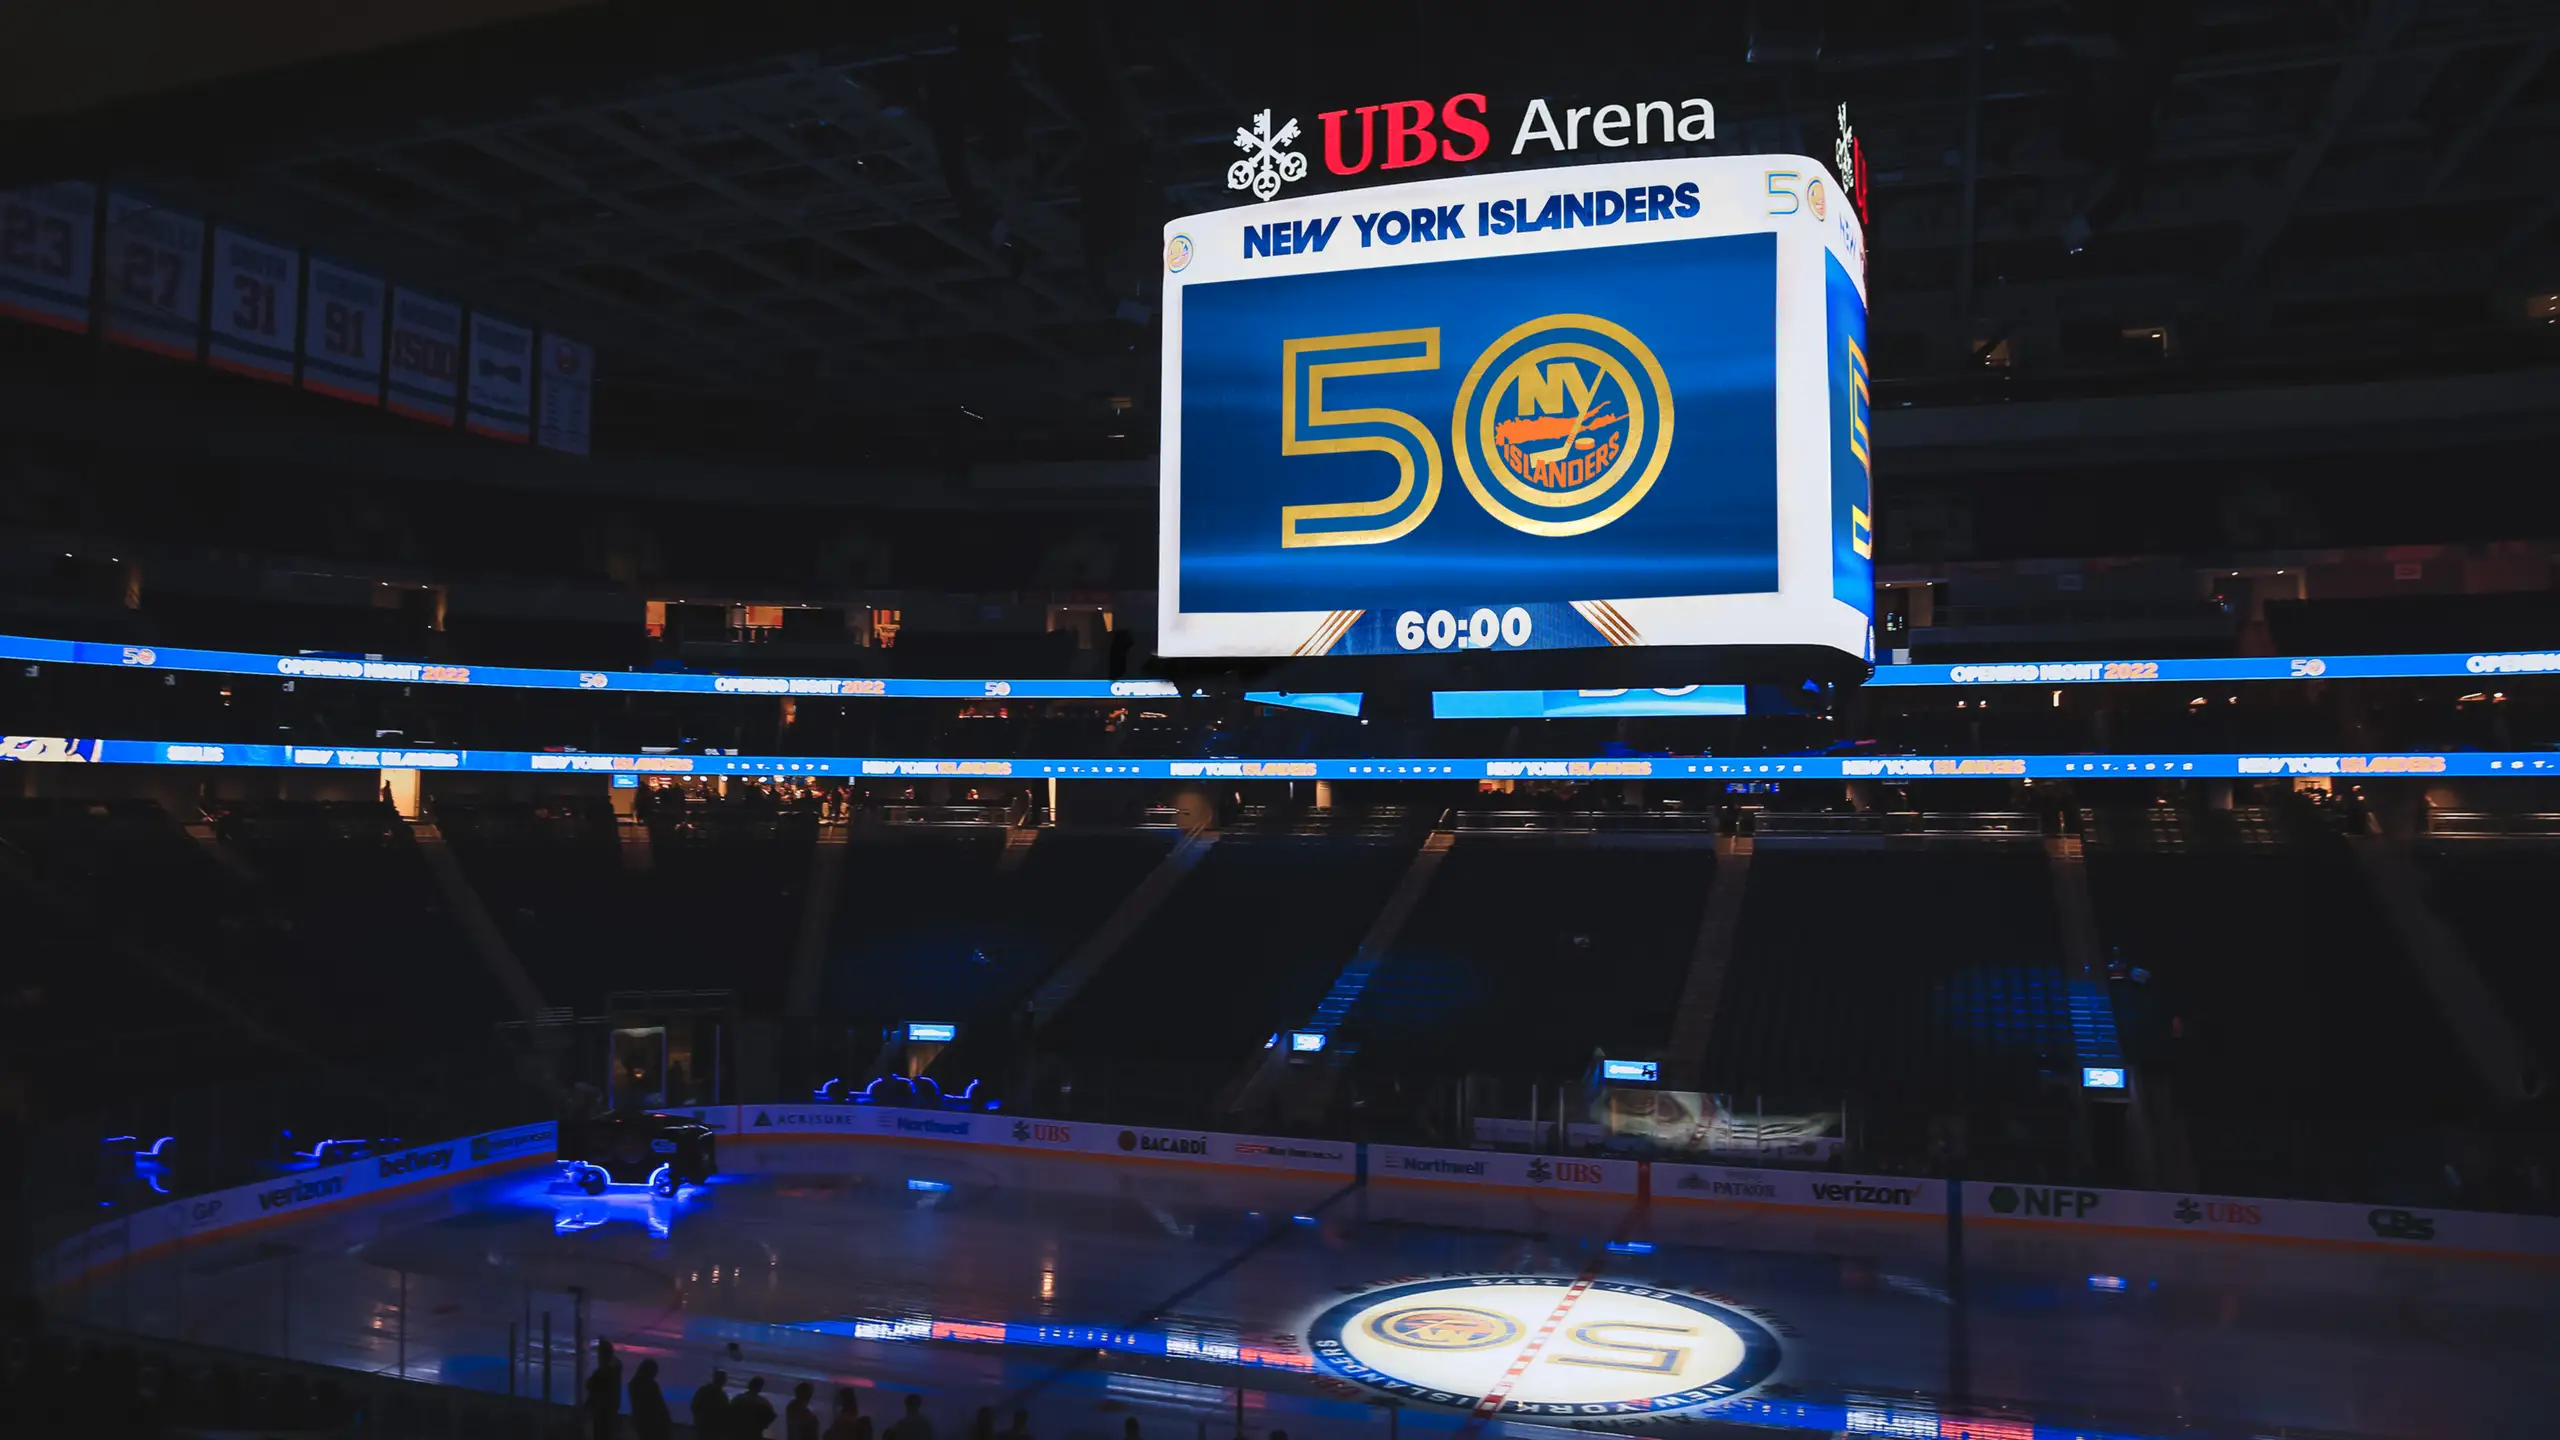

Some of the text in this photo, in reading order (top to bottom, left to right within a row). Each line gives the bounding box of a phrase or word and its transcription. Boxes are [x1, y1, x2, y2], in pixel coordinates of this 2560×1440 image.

[1318, 92, 1716, 176] UBS Arena
[1243, 181, 1701, 259] NEW YORK ISLANDERS
[2, 203, 72, 280] 23
[123, 240, 186, 311] 27
[231, 273, 277, 337] 31
[324, 300, 366, 360] 91
[1516, 361, 1593, 419] NY
[1282, 313, 1675, 549] 50
[1502, 436, 1621, 489] ISLANDERS
[1395, 606, 1533, 651] 60:00
[421, 666, 470, 683] 2022
[2103, 662, 2159, 680] 2022
[841, 680, 885, 695] 2022
[897, 1116, 971, 1135] Northwell
[1033, 1123, 1071, 1143] UBS
[1140, 1135, 1208, 1156] BACARDÍ
[379, 1146, 456, 1179] betway
[1403, 1156, 1486, 1176] Northwell
[1555, 1162, 1604, 1184] UBS
[257, 1174, 344, 1211] verizon
[1811, 1179, 1912, 1206] verizon
[2023, 1187, 2101, 1219] NFP
[2204, 1202, 2262, 1225] UBS
[1314, 1339, 1470, 1406] ISLANDERS
[1514, 1400, 1646, 1416] YORK
[1654, 1383, 1736, 1409] NEW
